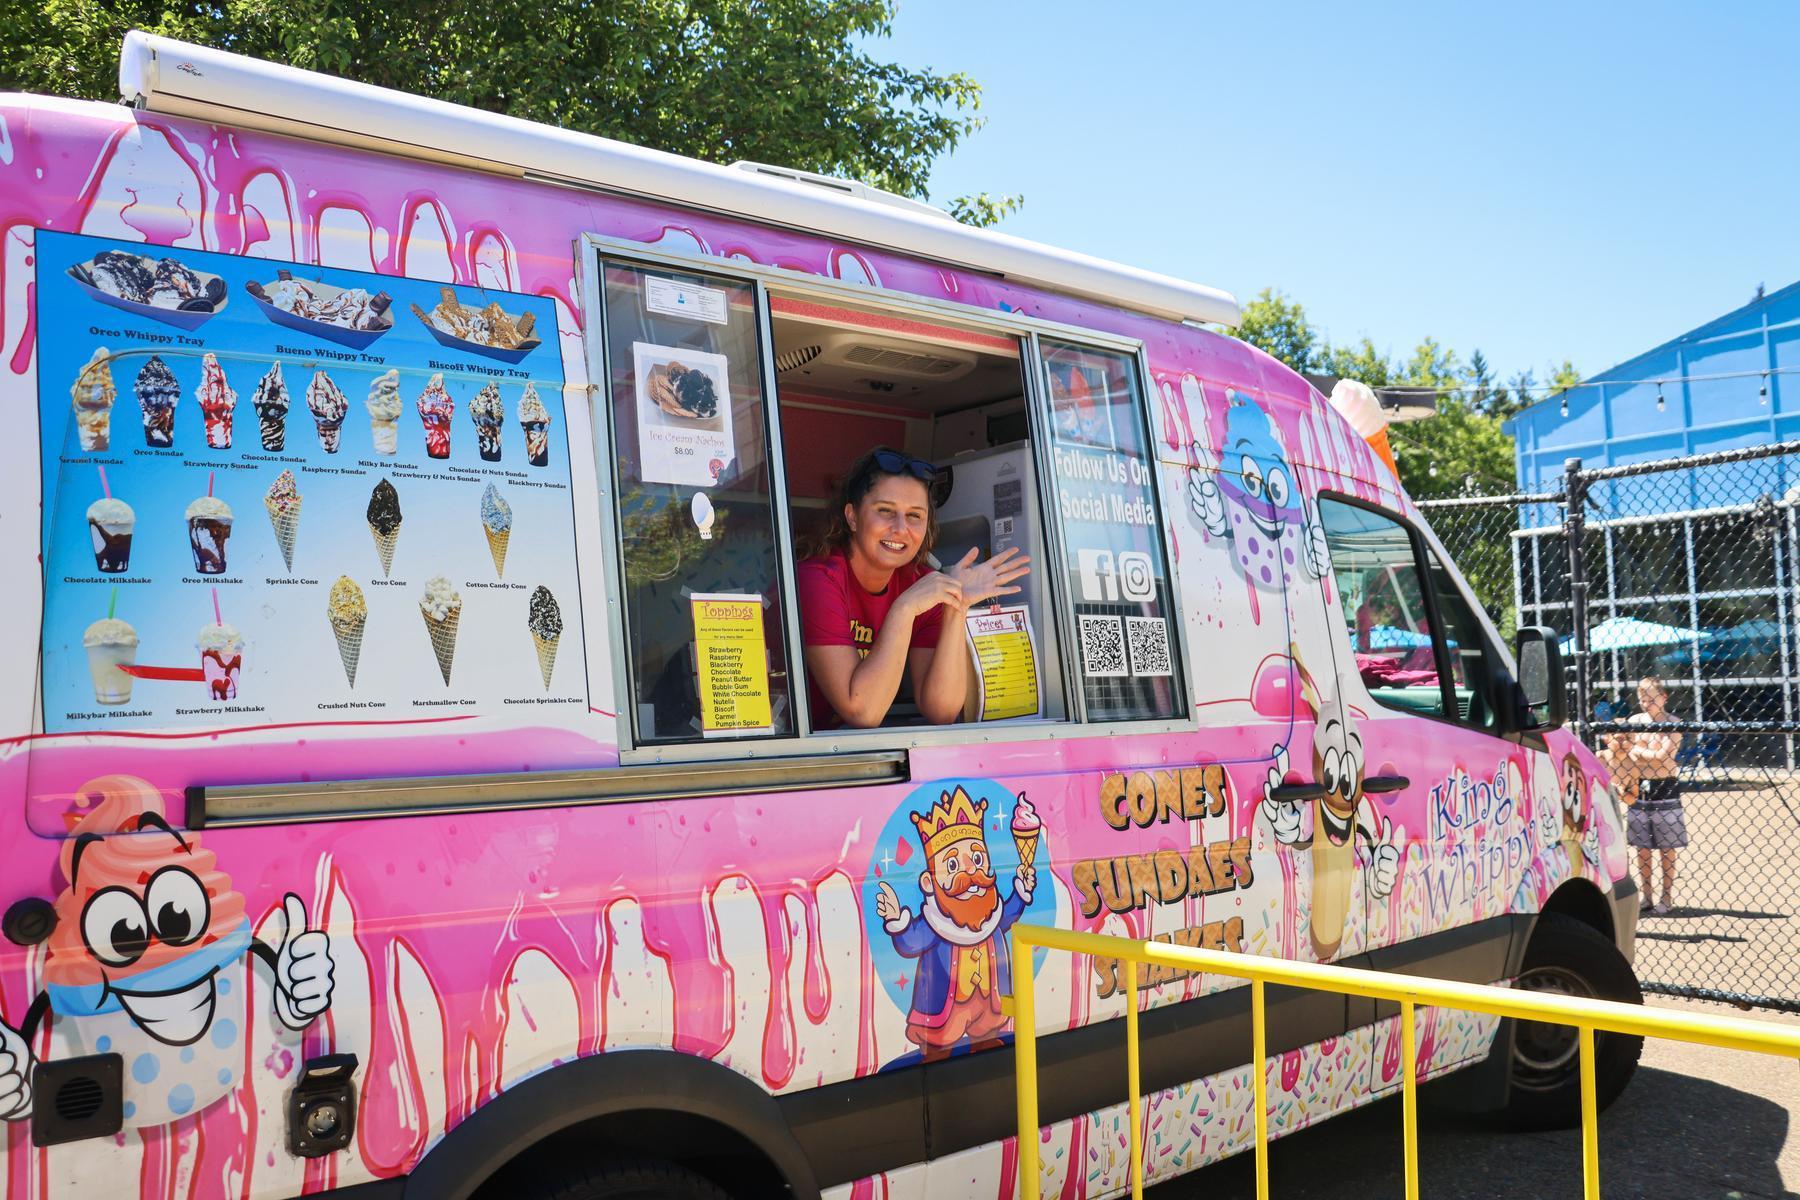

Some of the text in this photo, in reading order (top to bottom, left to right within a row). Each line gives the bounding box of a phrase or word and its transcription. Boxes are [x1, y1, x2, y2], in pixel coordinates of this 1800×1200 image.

[90, 327, 205, 347] Oreo Whippy Tray
[276, 345, 385, 365] Bueno Whippy Tray
[429, 361, 530, 378] Biscoff Whippy Tray
[674, 447, 694, 455] $8.00
[93, 457, 123, 465] Sundae
[241, 453, 307, 463] Chocolate Sundae
[183, 460, 259, 470] Strawberry Sundae
[301, 466, 338, 475] Raspberry
[358, 460, 419, 470] Milky Bar Sundae
[1054, 447, 1151, 487] Follow Us On
[391, 471, 432, 480] Strawberry
[457, 475, 481, 483] Sundae
[448, 466, 480, 474] Chocolate
[505, 470, 528, 478] Sundae
[508, 479, 543, 488] Blackberry
[1060, 489, 1156, 525] Social Media
[466, 581, 488, 589] Cotton
[490, 582, 509, 591] Candy
[701, 602, 753, 620] Toppings
[709, 646, 743, 654] Strawberry
[536, 697, 565, 705] Sprinkles
[67, 710, 153, 721] Milkybar Milkshake
[176, 705, 266, 716] Strawberry Milkshake
[742, 719, 760, 727] Spice
[1100, 764, 1226, 831] CONES
[1432, 760, 1513, 842] King
[1420, 819, 1536, 920] Whippy
[1072, 837, 1254, 919] SUNDAES
